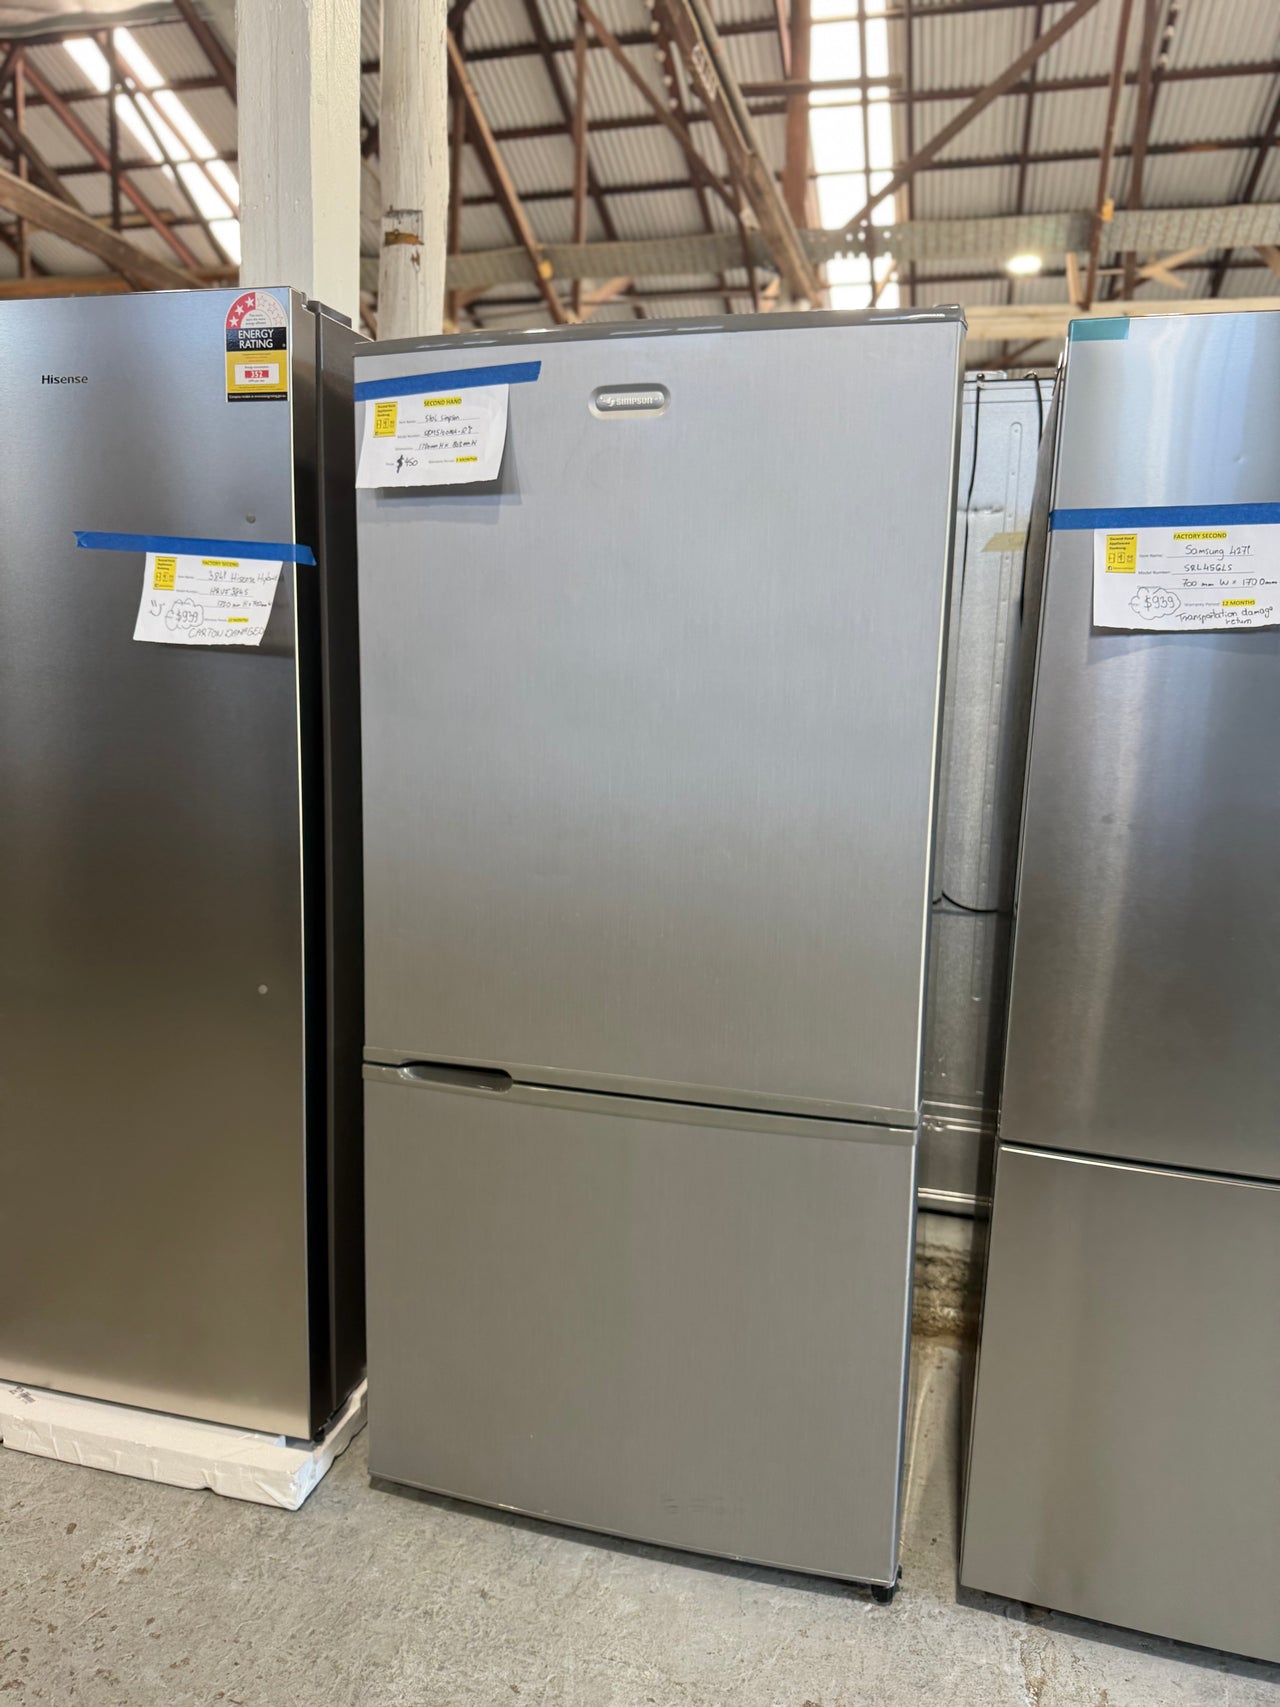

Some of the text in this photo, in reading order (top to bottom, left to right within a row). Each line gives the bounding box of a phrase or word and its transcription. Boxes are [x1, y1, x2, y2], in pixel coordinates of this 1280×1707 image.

[238, 329, 274, 339] ENERGY
[239, 339, 274, 349] RATING
[250, 370, 264, 378] 352
[41, 374, 89, 385] Hisense
[424, 399, 446, 407] SECOND
[396, 454, 419, 474] $450
[1173, 531, 1227, 540] FACTORY SECOND
[1185, 544, 1225, 561] Samsung
[1182, 578, 1198, 587] 700
[1143, 594, 1175, 612] $939
[1176, 608, 1238, 624] Transportation
[1225, 617, 1252, 625] return
